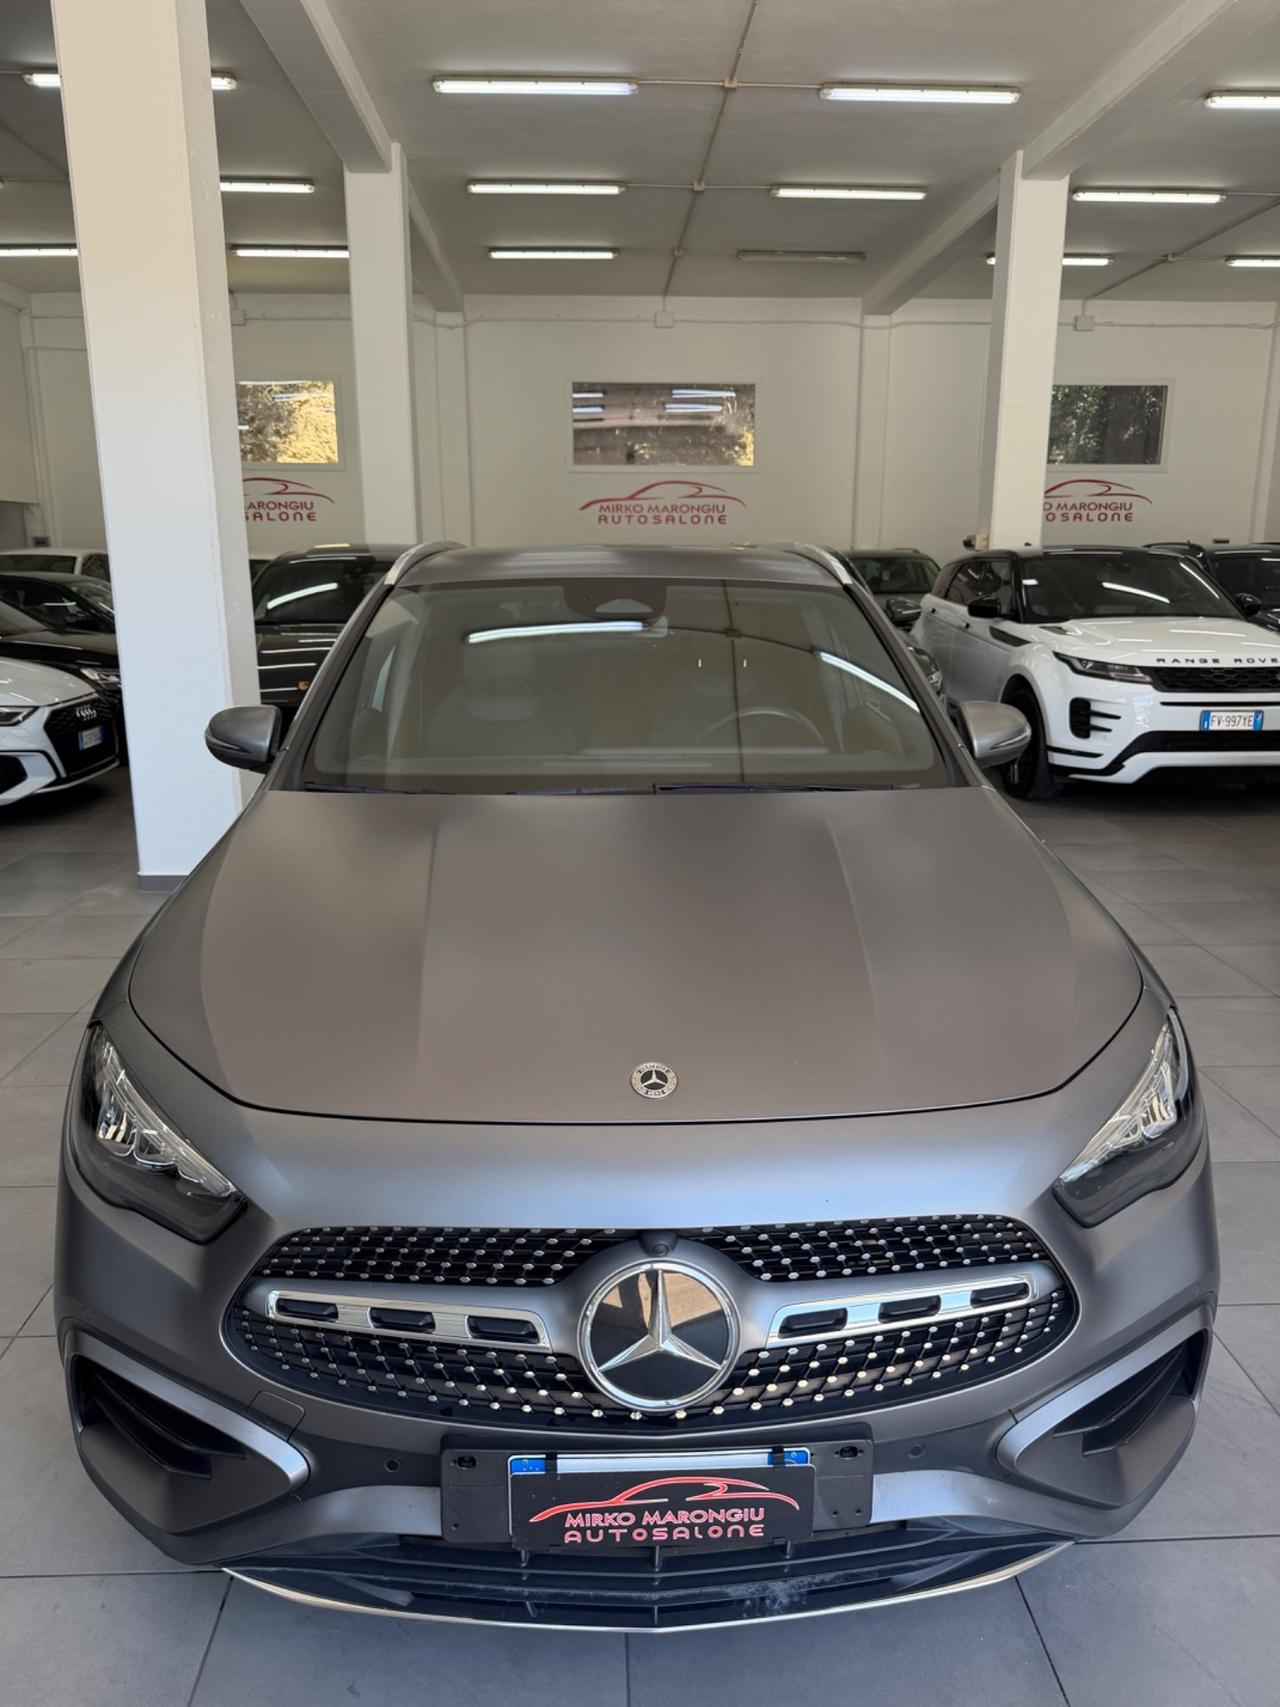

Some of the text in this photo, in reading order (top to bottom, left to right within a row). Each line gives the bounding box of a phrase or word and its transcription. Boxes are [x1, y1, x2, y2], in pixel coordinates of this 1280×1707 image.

[247, 501, 314, 510] ARONGIU
[599, 504, 725, 513] MIRKO MARONGIU
[1056, 502, 1133, 511] MARONGIU
[598, 515, 727, 525] AUTOSALONE
[1045, 512, 1134, 522] OSALONE
[564, 1507, 765, 1528] MIRKO MARONGIU
[564, 1524, 765, 1543] AUTOSALONE
